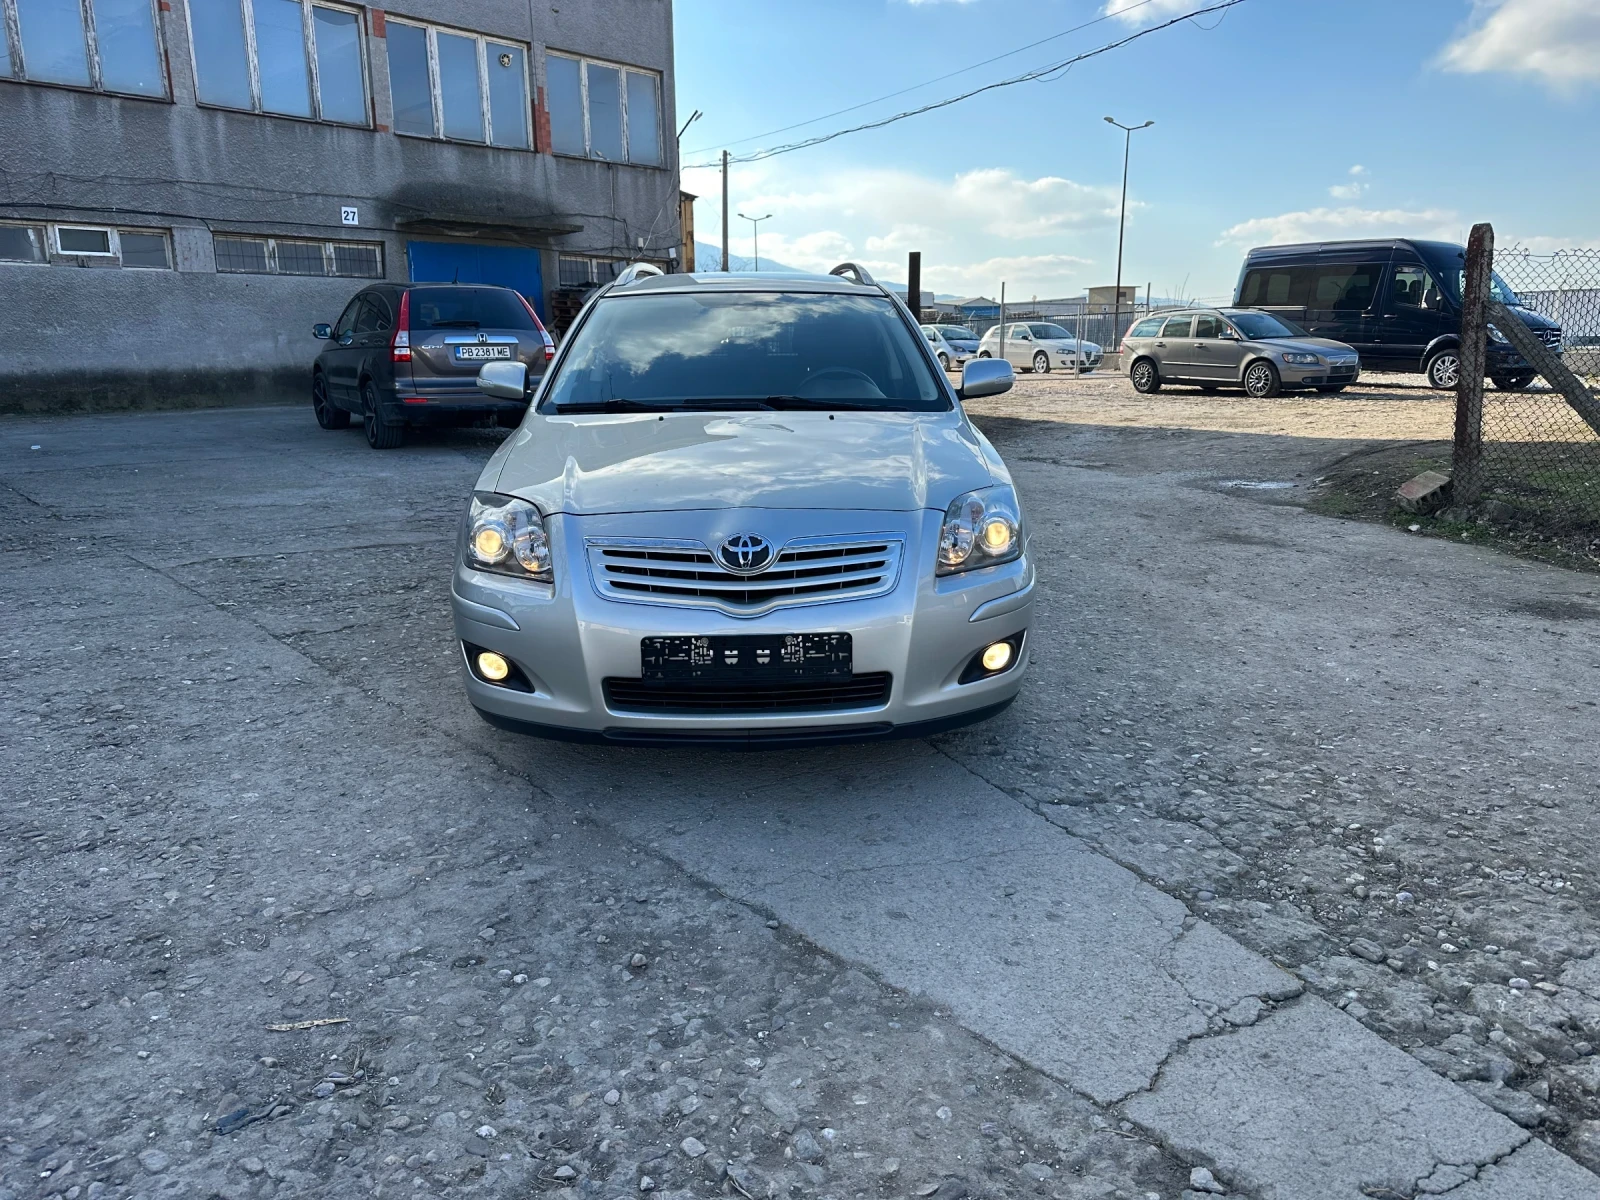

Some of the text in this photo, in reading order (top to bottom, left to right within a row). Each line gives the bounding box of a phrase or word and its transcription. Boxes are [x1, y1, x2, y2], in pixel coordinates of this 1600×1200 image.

[343, 210, 356, 221] 27
[461, 346, 509, 357] PB 2381 ME
